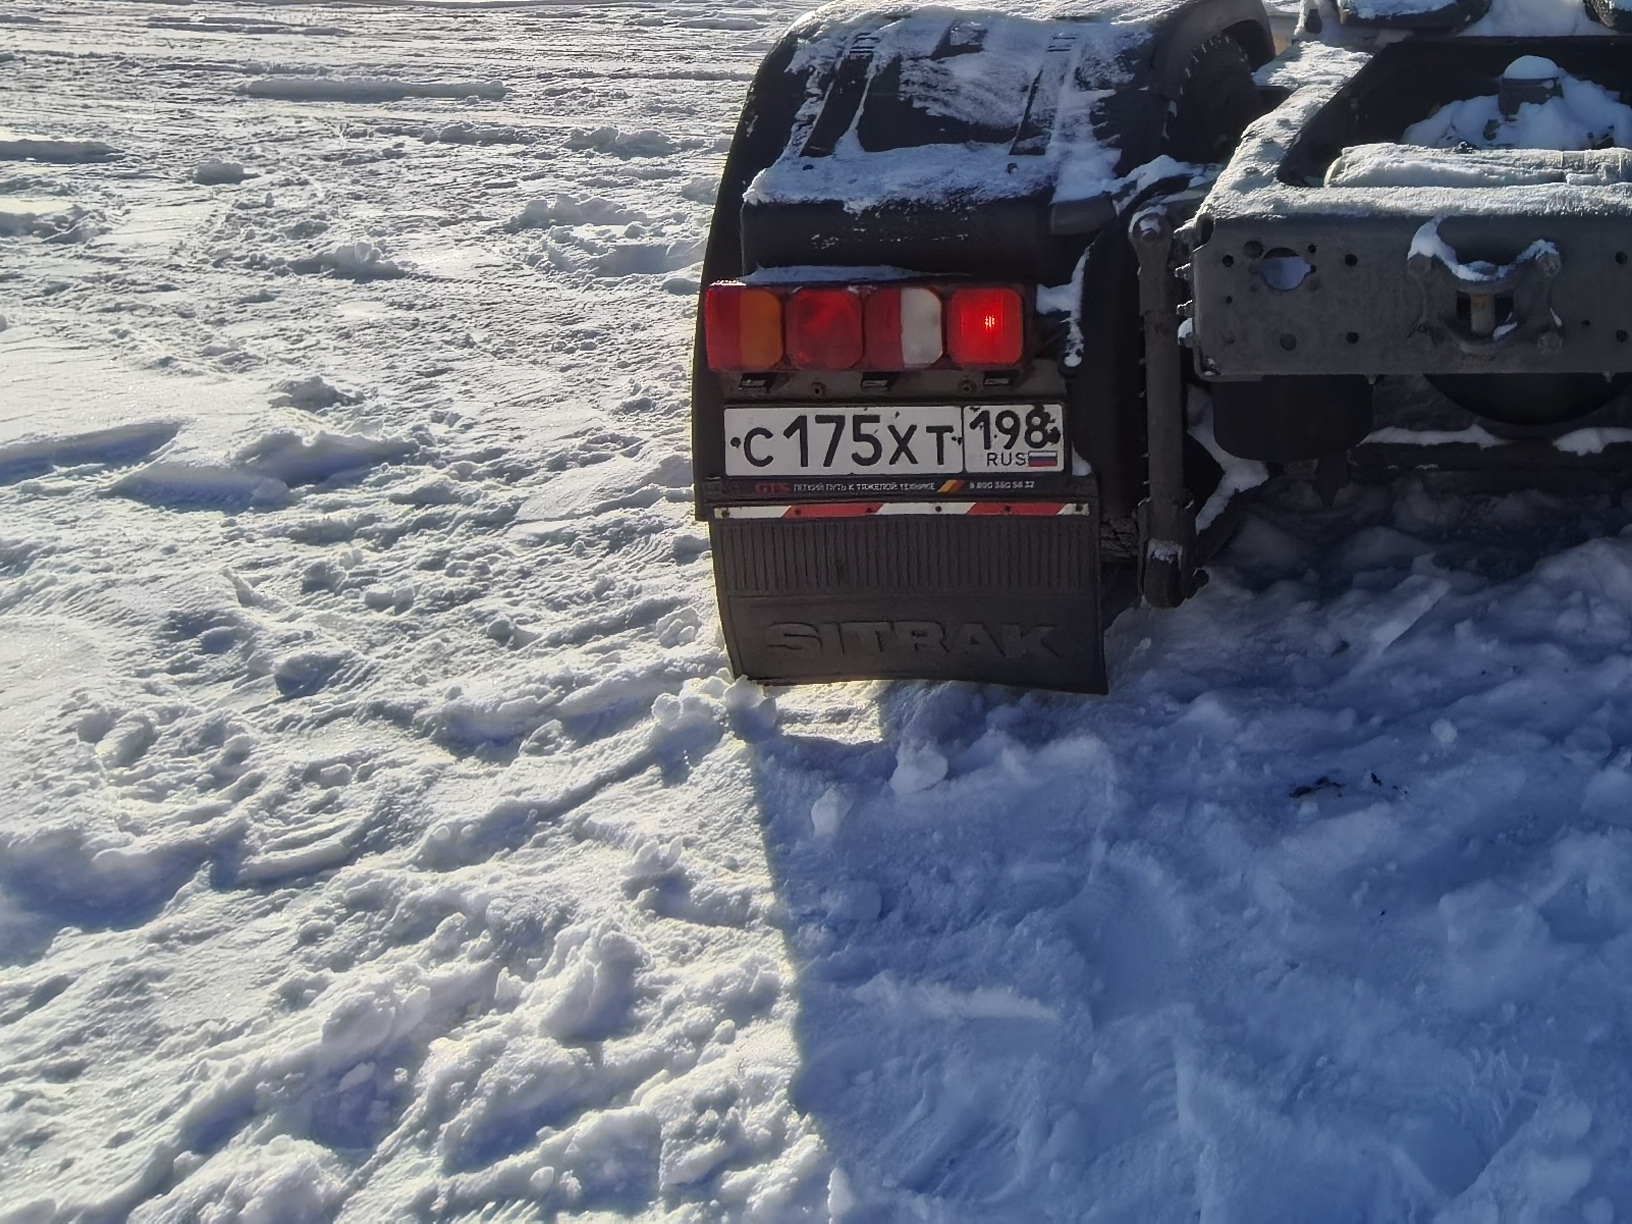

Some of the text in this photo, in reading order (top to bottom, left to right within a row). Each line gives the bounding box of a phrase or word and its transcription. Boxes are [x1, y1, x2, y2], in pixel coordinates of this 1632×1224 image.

[969, 409, 1052, 450] 198
[987, 452, 1026, 467] RUS
[764, 619, 1066, 659] SITRAK
